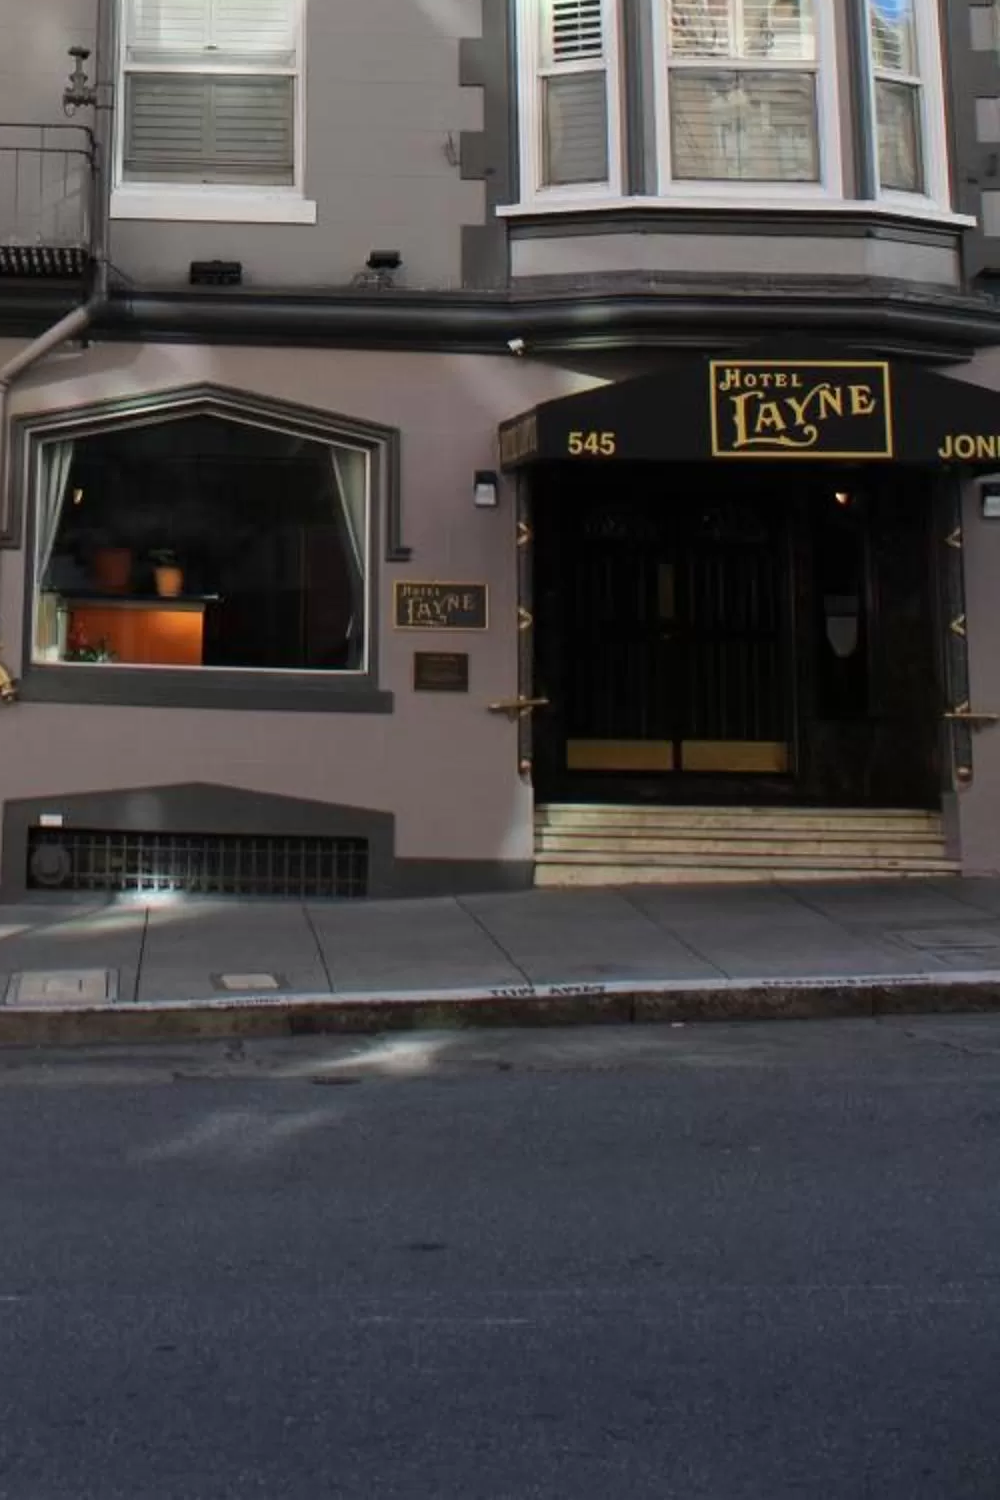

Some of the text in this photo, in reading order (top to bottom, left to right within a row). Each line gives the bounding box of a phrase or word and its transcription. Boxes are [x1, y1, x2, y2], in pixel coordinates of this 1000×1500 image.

[719, 368, 804, 391] HOTEL
[730, 383, 876, 448] LAYNE
[567, 431, 616, 456] 545
[937, 434, 1000, 459] JON
